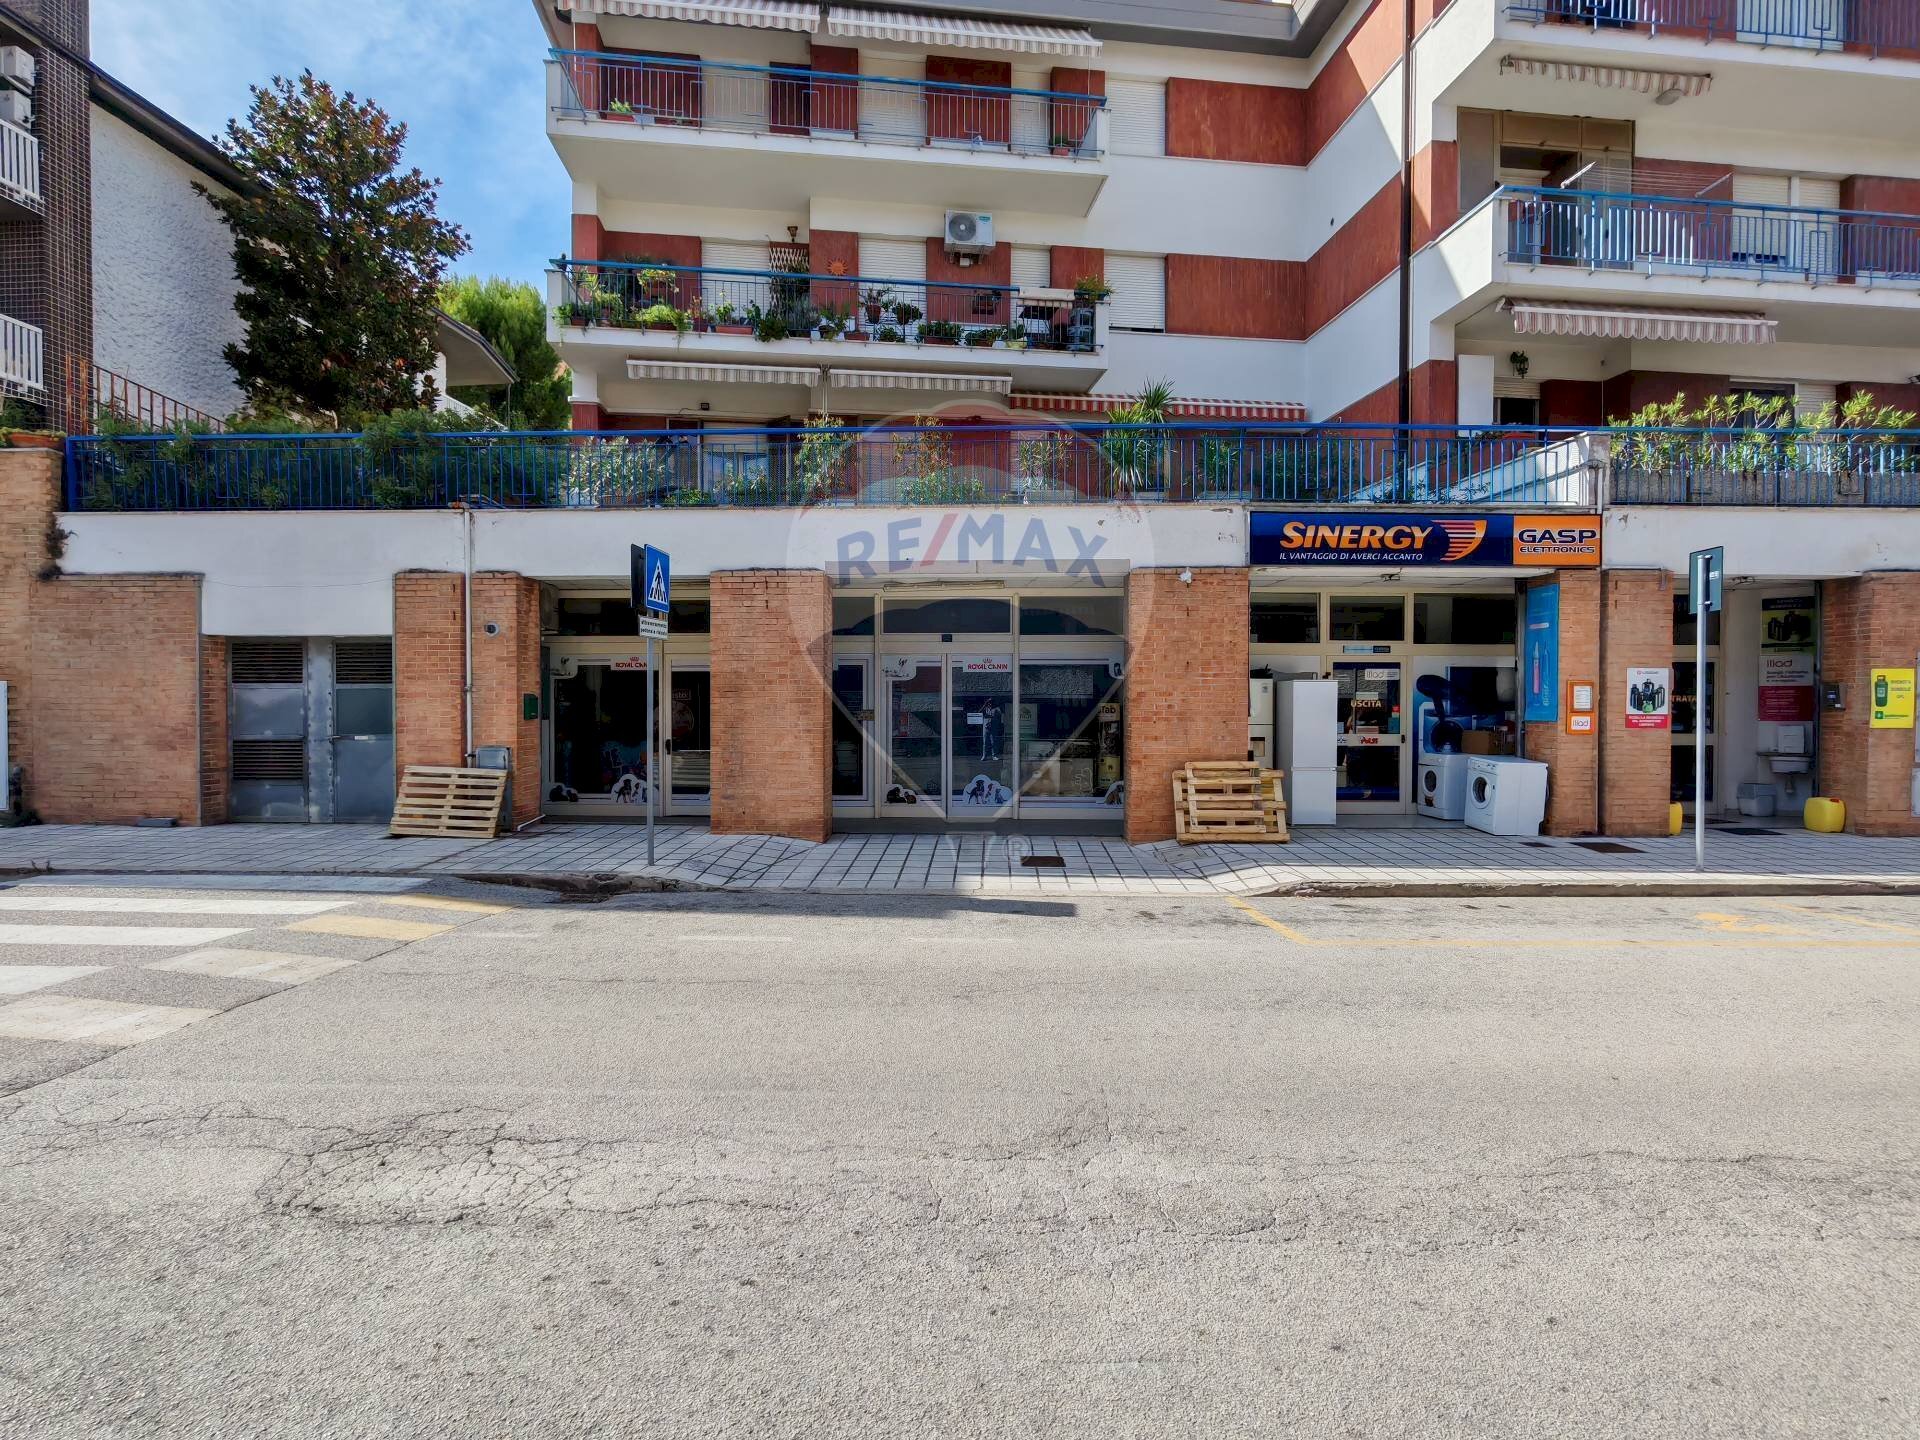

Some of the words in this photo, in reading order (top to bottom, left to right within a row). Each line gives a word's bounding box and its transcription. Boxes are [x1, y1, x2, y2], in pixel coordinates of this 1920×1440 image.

[1279, 521, 1433, 549] SINERGY
[1518, 528, 1597, 544] GASP
[1279, 552, 1288, 560] IL
[1289, 552, 1338, 560] VANTAGGIO
[1339, 552, 1349, 560] DI
[1351, 552, 1381, 560] AVERCI
[1382, 553, 1423, 561] ACCANTO
[1350, 700, 1382, 708] USCITA
